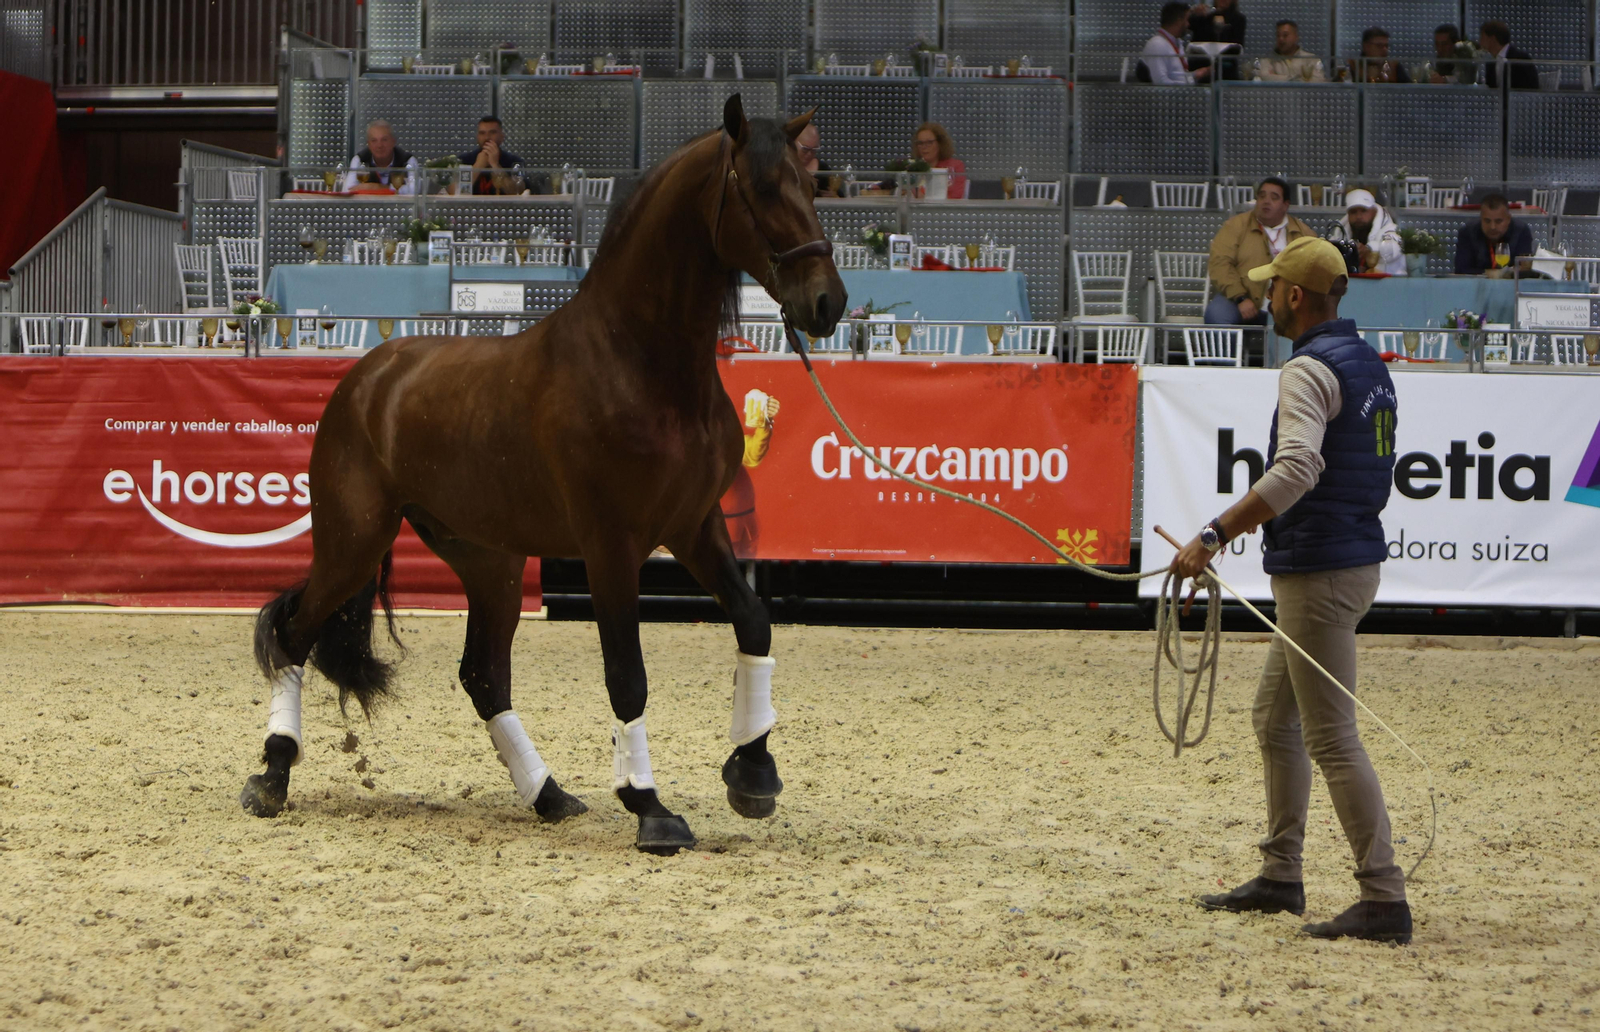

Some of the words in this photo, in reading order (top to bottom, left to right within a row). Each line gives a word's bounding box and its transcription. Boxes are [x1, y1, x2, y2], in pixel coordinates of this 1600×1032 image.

[1360, 391, 1375, 418] FINCA
[104, 418, 166, 433] Comprar
[170, 421, 178, 434] y
[182, 418, 231, 431] vender
[234, 419, 293, 433] caballos
[811, 431, 1069, 490] Cruzcampo
[1217, 427, 1551, 501] hetia
[878, 491, 936, 502] DESDE
[1471, 534, 1550, 562] suiza
